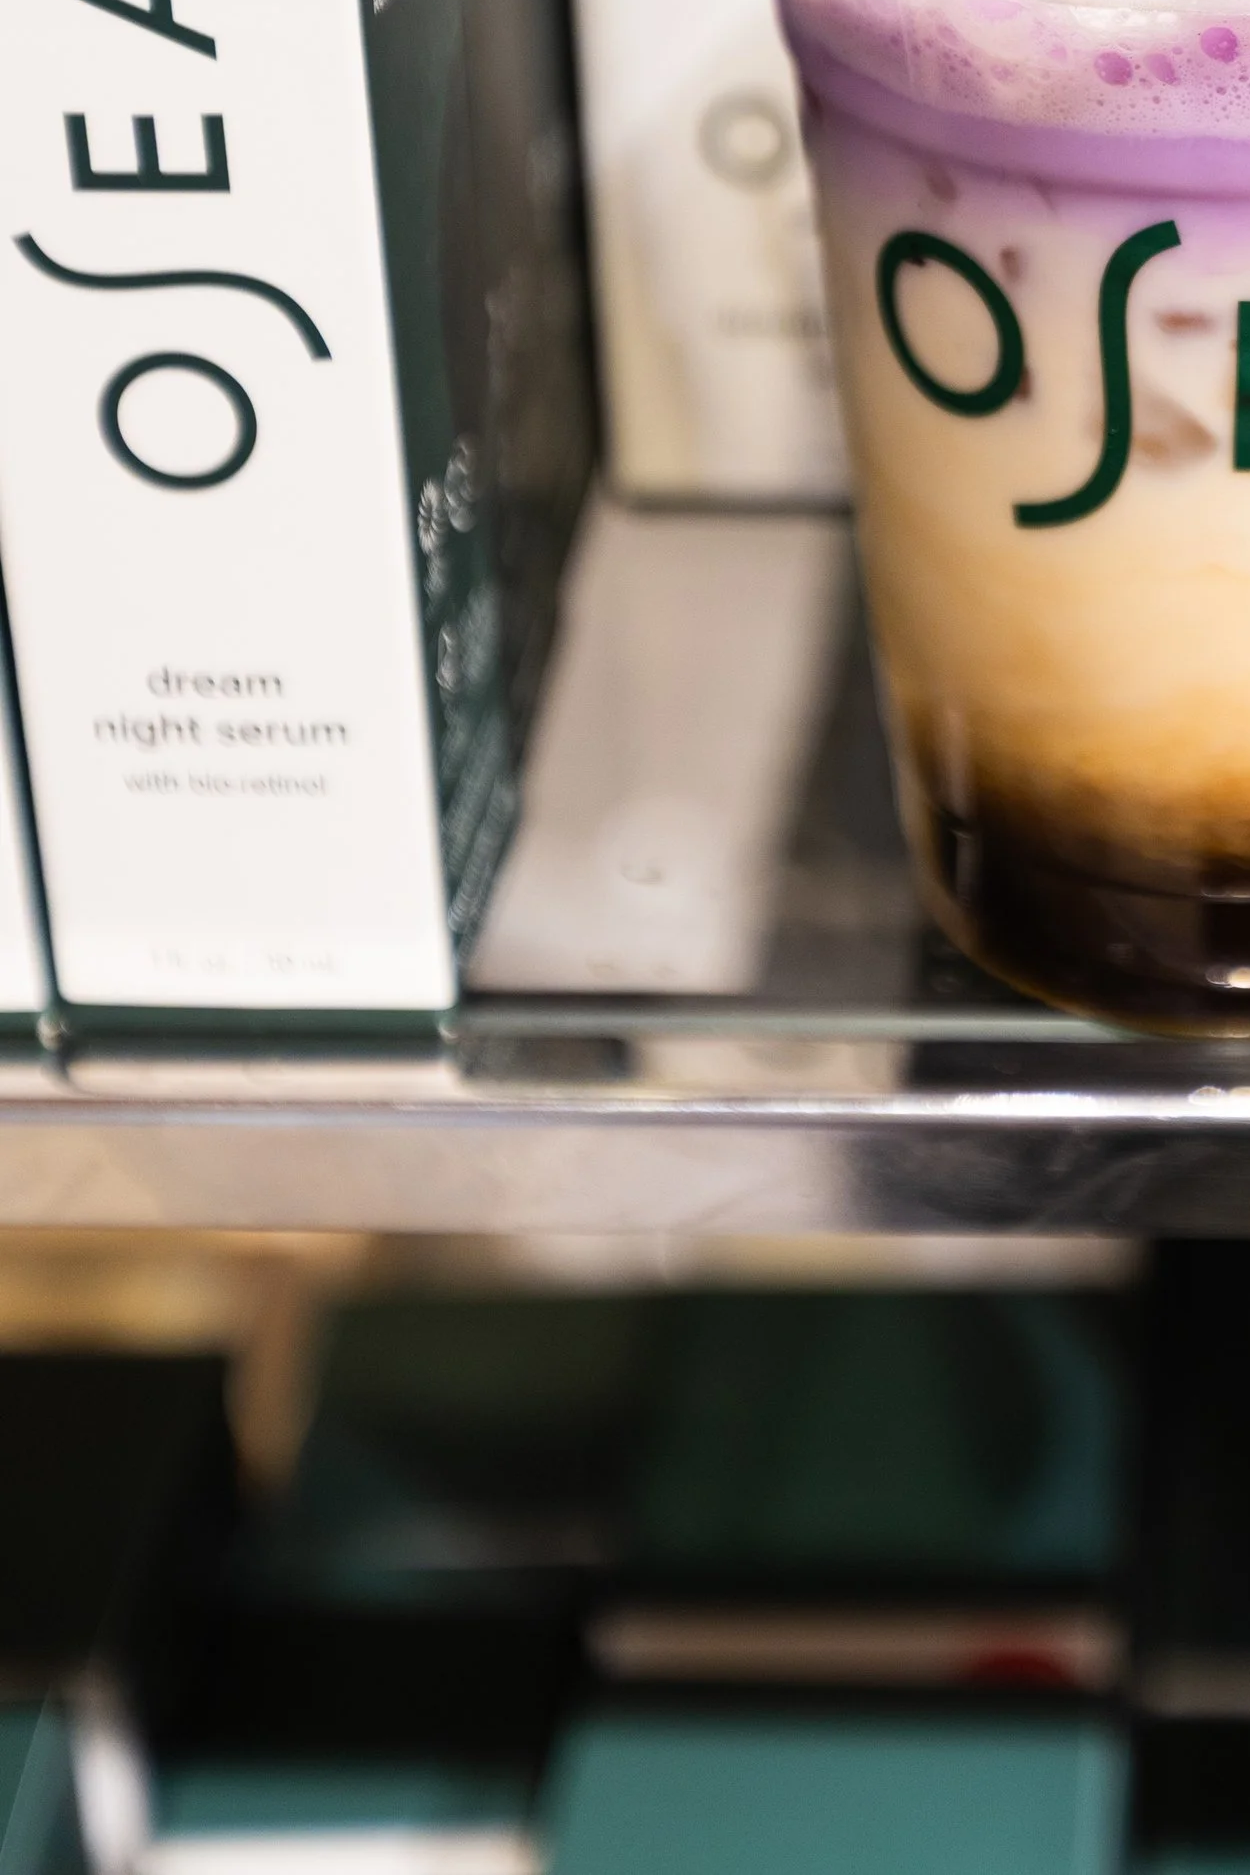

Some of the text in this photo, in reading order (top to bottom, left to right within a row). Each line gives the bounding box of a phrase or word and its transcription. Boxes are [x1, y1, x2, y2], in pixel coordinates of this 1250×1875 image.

[146, 663, 285, 699] dream
[92, 709, 348, 753] night serum
[122, 768, 180, 795] with
